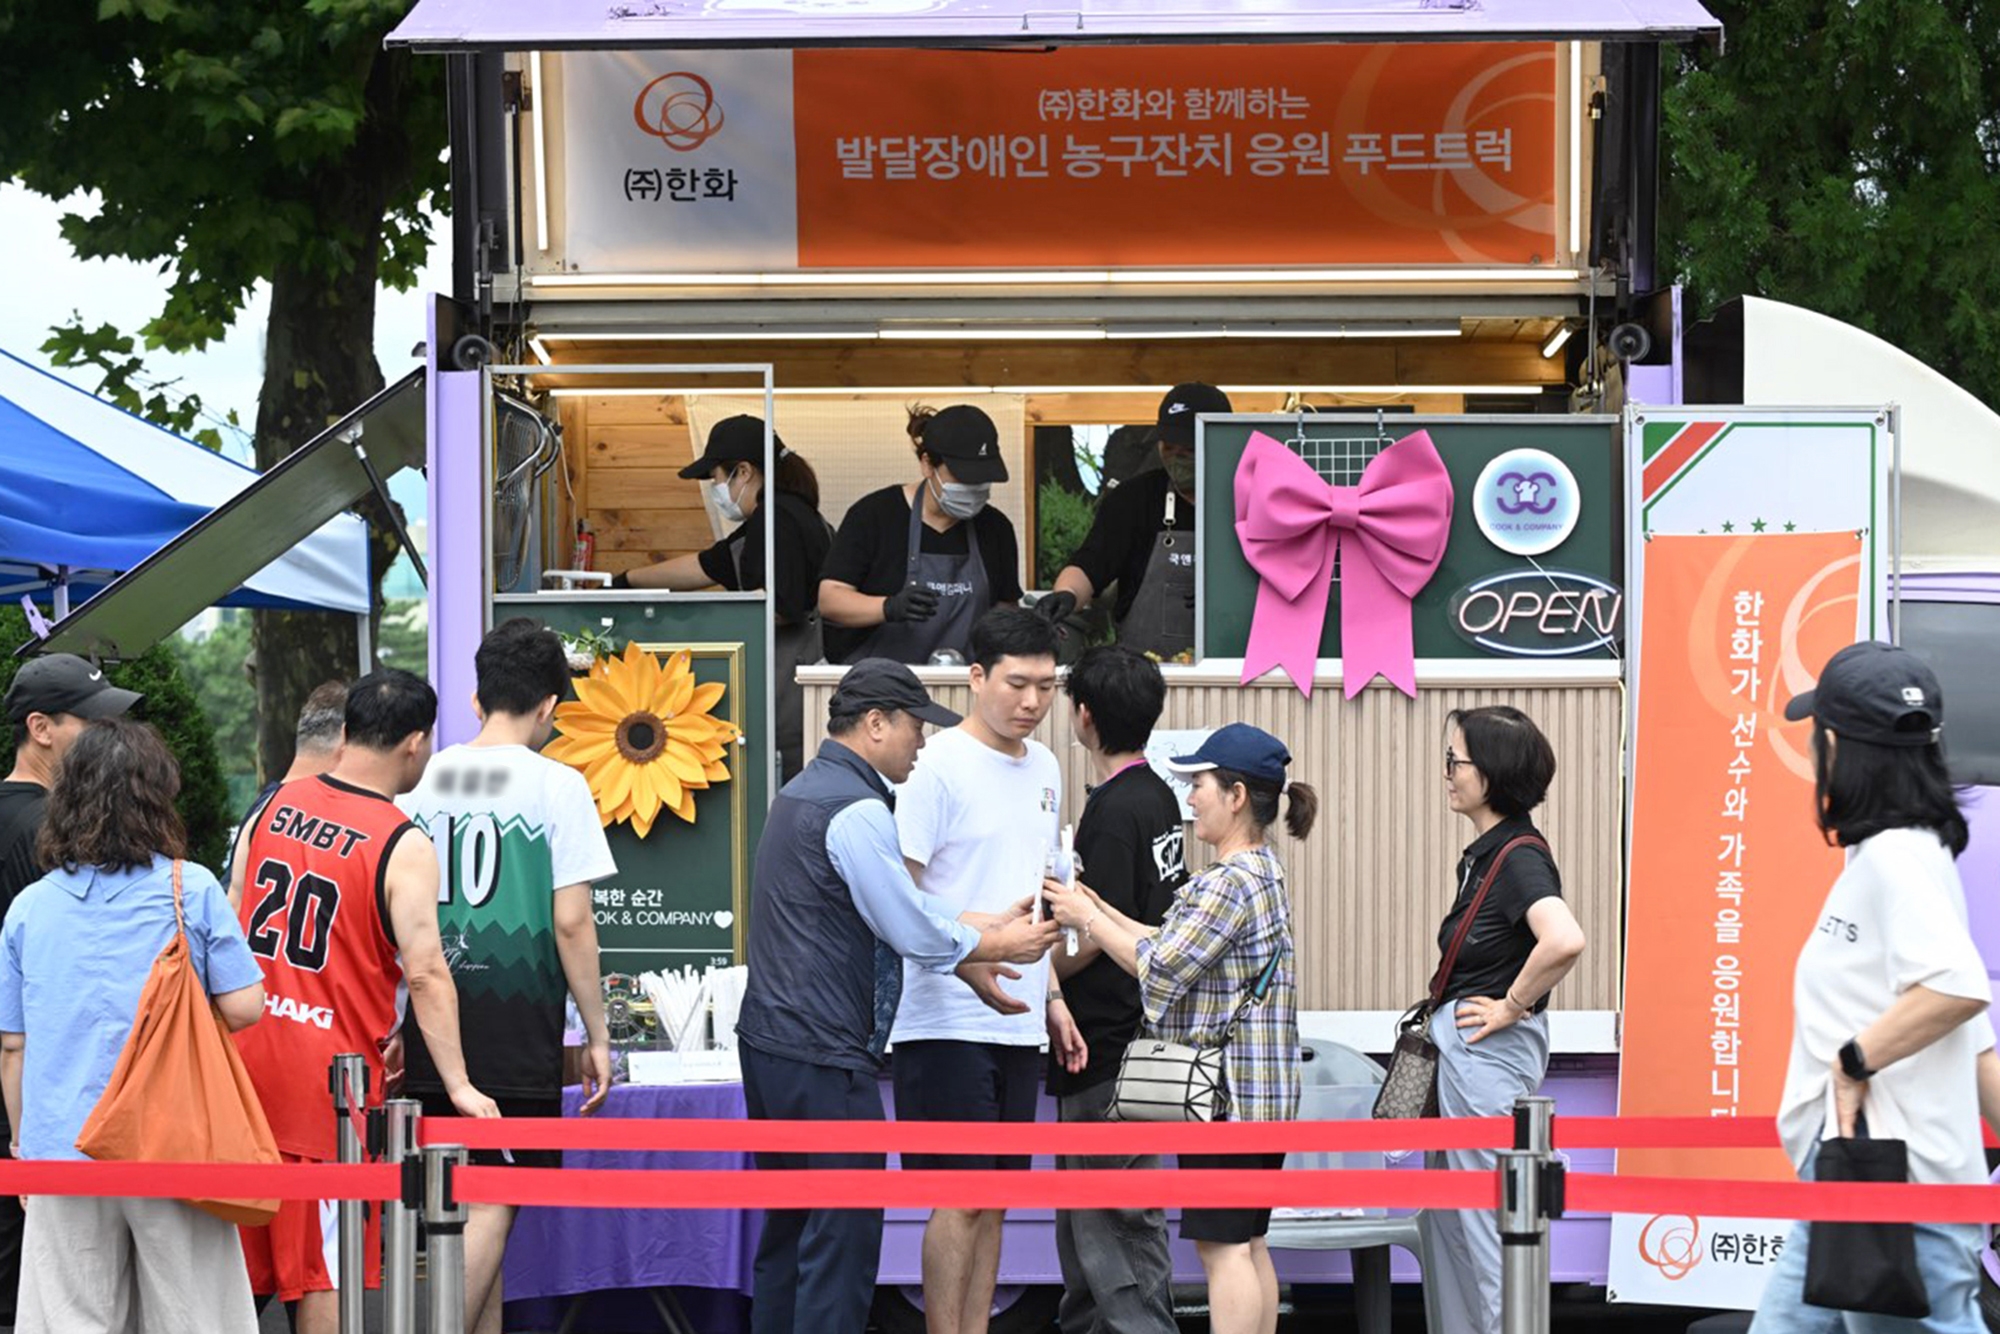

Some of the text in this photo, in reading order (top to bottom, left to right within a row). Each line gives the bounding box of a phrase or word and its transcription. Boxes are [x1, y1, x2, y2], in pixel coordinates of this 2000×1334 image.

[1038, 88, 1310, 121] (주)한화와 함께하는
[836, 128, 1512, 180] 발달장애인 농구잔치 응원 푸드트럭
[624, 168, 738, 202] (주)한화
[1490, 523, 1514, 531] COOK
[1523, 523, 1563, 531] COMPANY
[1459, 591, 1622, 634] OPEN
[269, 804, 371, 860] SMBT
[427, 812, 502, 909] 10
[1710, 591, 1764, 1117] 한화가 선수와 가족을 응원합니
[247, 857, 342, 974] 20
[589, 888, 664, 907] 복한 순간
[592, 911, 713, 925] OK & COMPANY
[709, 956, 728, 967] 3:59
